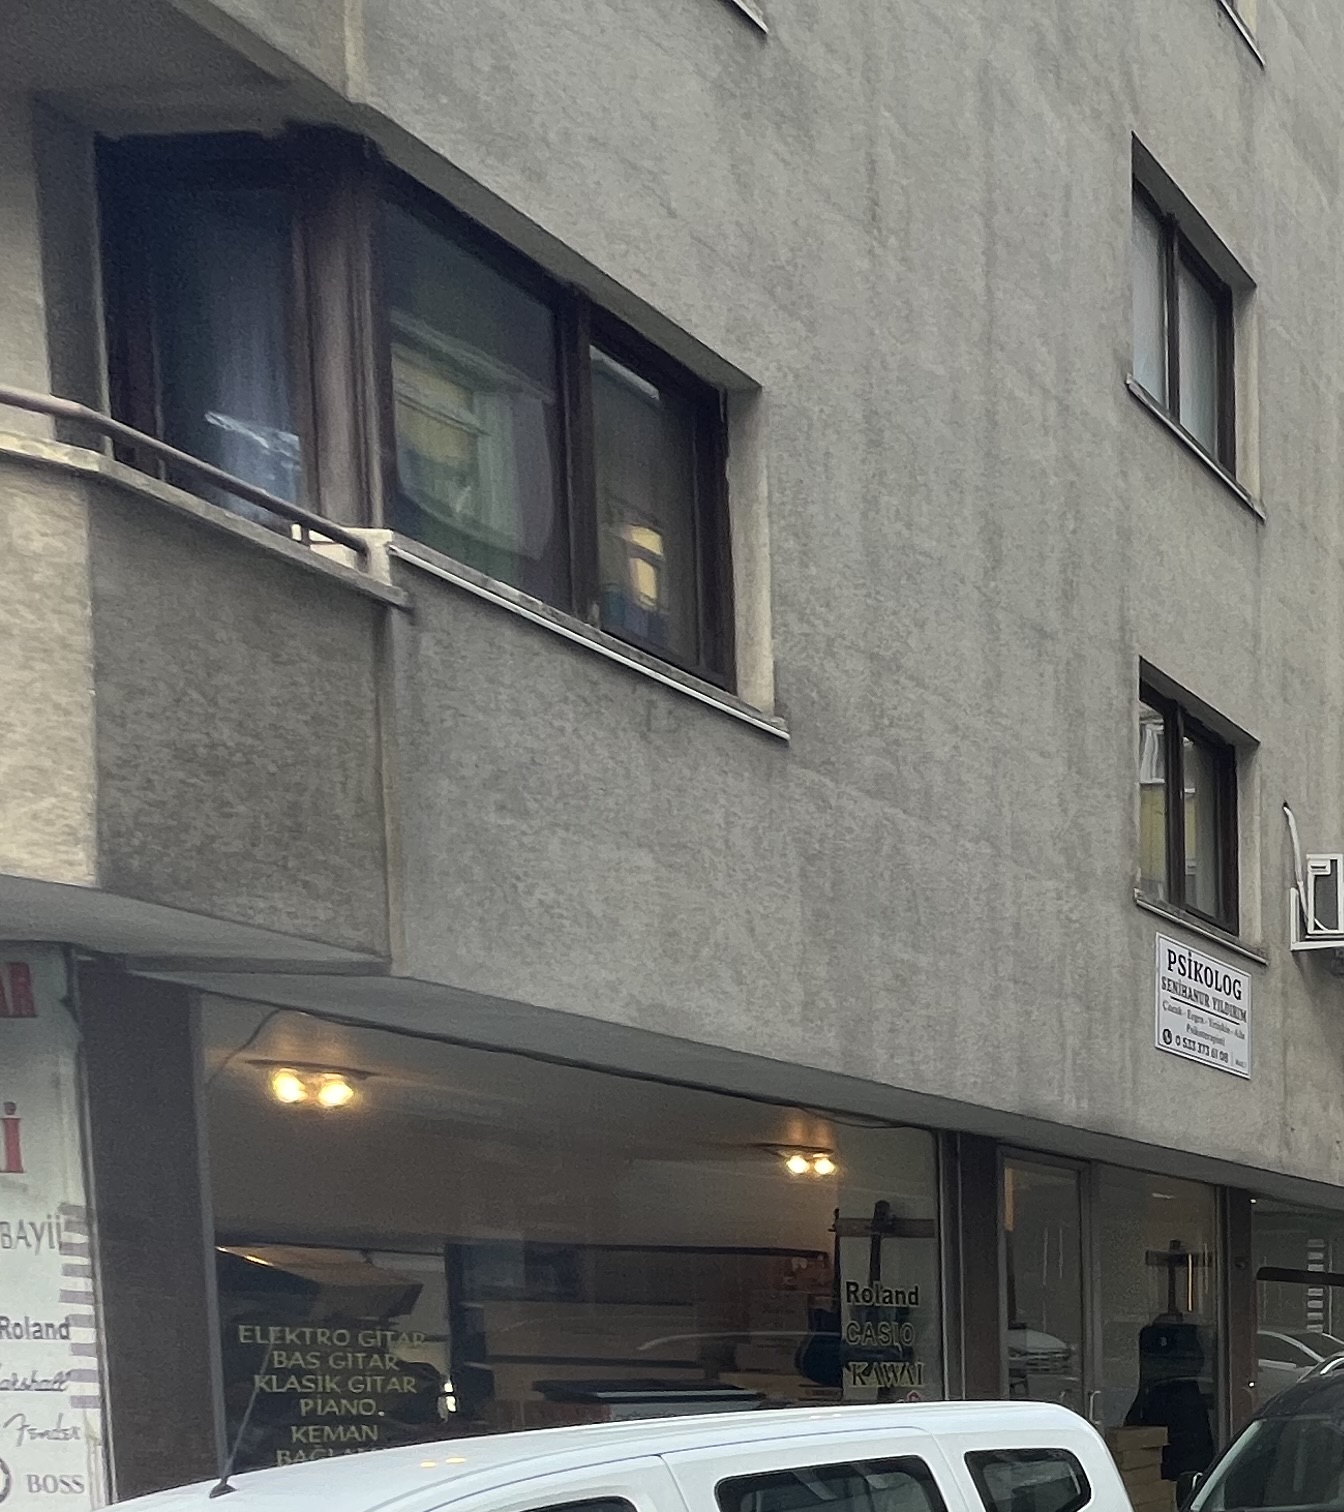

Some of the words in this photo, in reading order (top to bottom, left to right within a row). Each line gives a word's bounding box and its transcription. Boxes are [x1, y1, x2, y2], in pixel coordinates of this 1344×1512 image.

[1166, 948, 1242, 1001] PSİKOLOG
[845, 1281, 919, 1306] Roland
[238, 1325, 351, 1347] ELEKTRO
[358, 1328, 426, 1348] GİTAR
[846, 1321, 914, 1346] CASIO
[273, 1350, 321, 1369] BAS
[328, 1351, 400, 1371] GİTAR
[348, 1371, 417, 1394] GİTAR
[848, 1361, 925, 1388] KAWAI
[3, 1412, 81, 1447] Fender
[291, 1425, 379, 1443] KEMAN
[26, 1474, 85, 1494] BOSS
